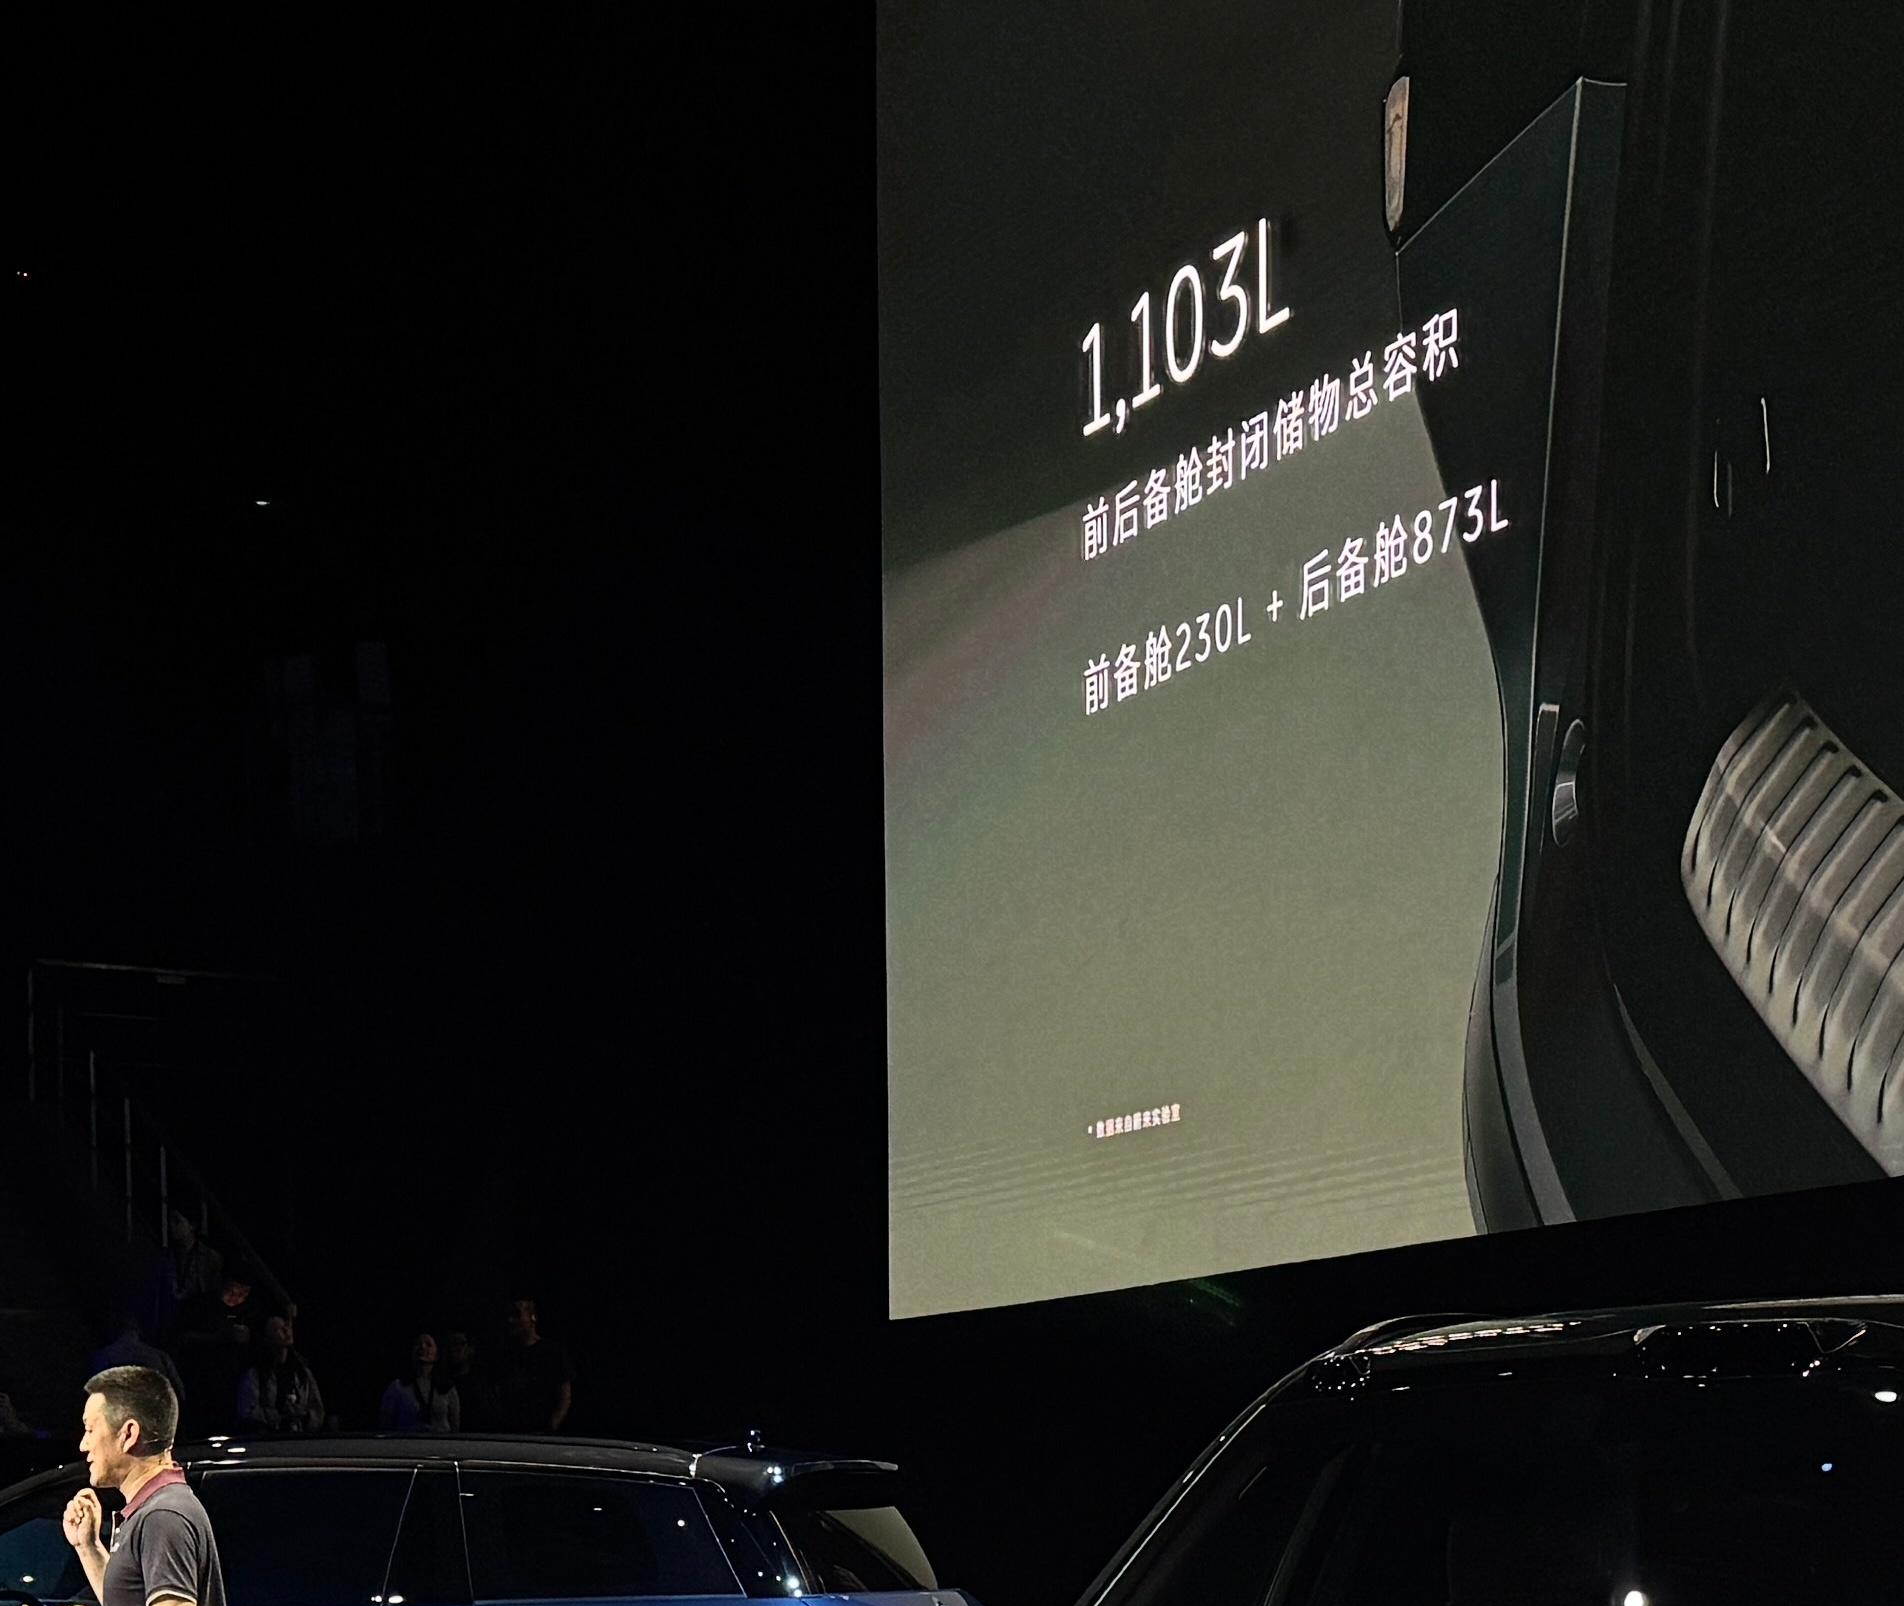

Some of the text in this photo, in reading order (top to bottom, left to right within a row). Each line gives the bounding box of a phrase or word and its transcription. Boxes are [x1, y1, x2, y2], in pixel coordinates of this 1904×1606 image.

[1082, 217, 1290, 437] 1,103L
[1082, 308, 1459, 561] 前后备舱封闭储物总容积
[1083, 479, 1509, 716] 前备舱230L + 后备舱873L
